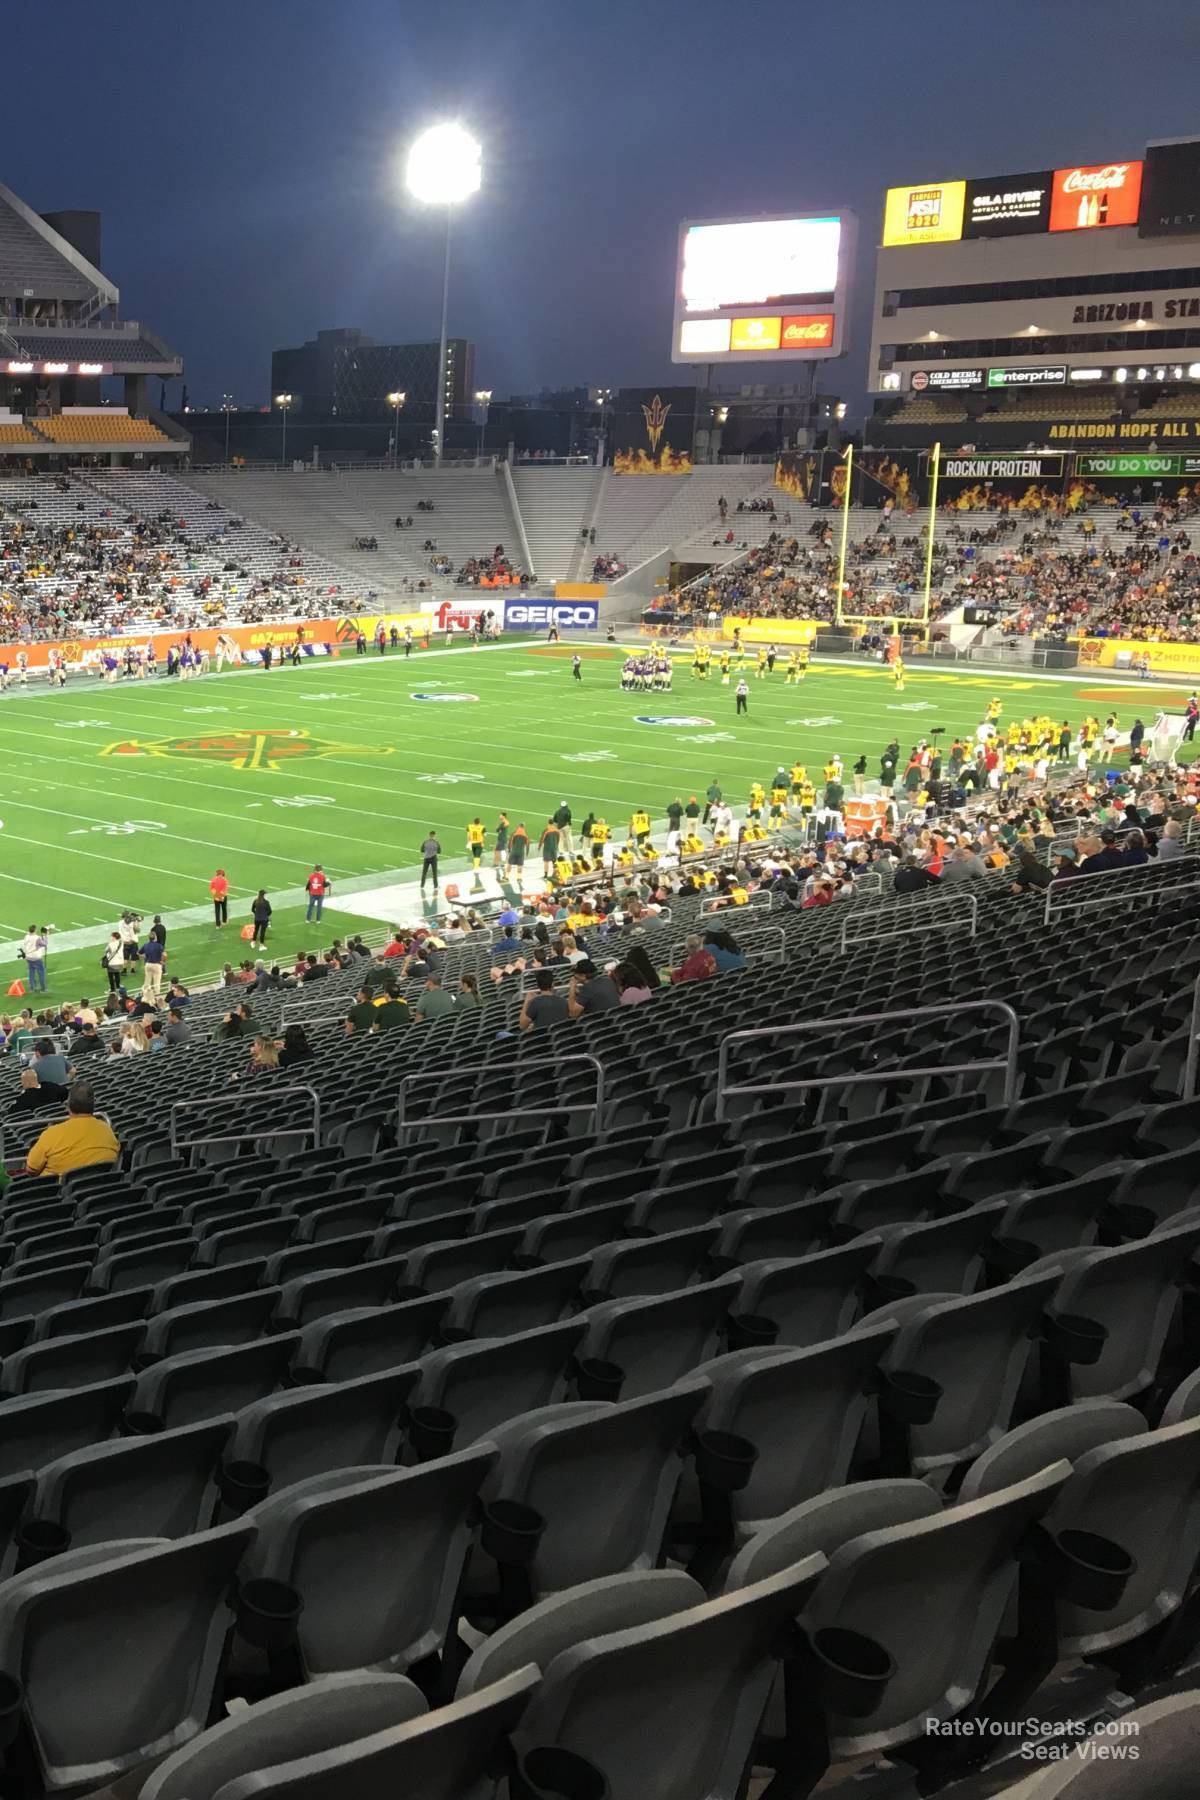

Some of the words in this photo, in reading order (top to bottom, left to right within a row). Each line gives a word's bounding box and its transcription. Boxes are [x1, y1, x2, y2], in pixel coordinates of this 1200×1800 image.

[1064, 166, 1129, 193] Coca-Cola
[973, 195, 1002, 206] GILA
[1003, 191, 1041, 203] RIVER
[909, 200, 940, 215] ASU
[908, 214, 939, 227] 2020
[1160, 215, 1196, 224] NET
[1073, 301, 1153, 323] ARIZONA
[784, 323, 829, 339] Coca-Cola
[993, 370, 1064, 383] enterprise
[1050, 424, 1115, 438] ABANDON
[1120, 424, 1158, 437] HOPE
[1162, 424, 1189, 437] ALL
[992, 460, 1041, 476] PROTEIN
[1088, 459, 1116, 471] YOU
[1118, 459, 1140, 471] DO
[1143, 459, 1172, 471] YOU
[506, 606, 596, 625] GEICO
[91, 820, 167, 834] 30
